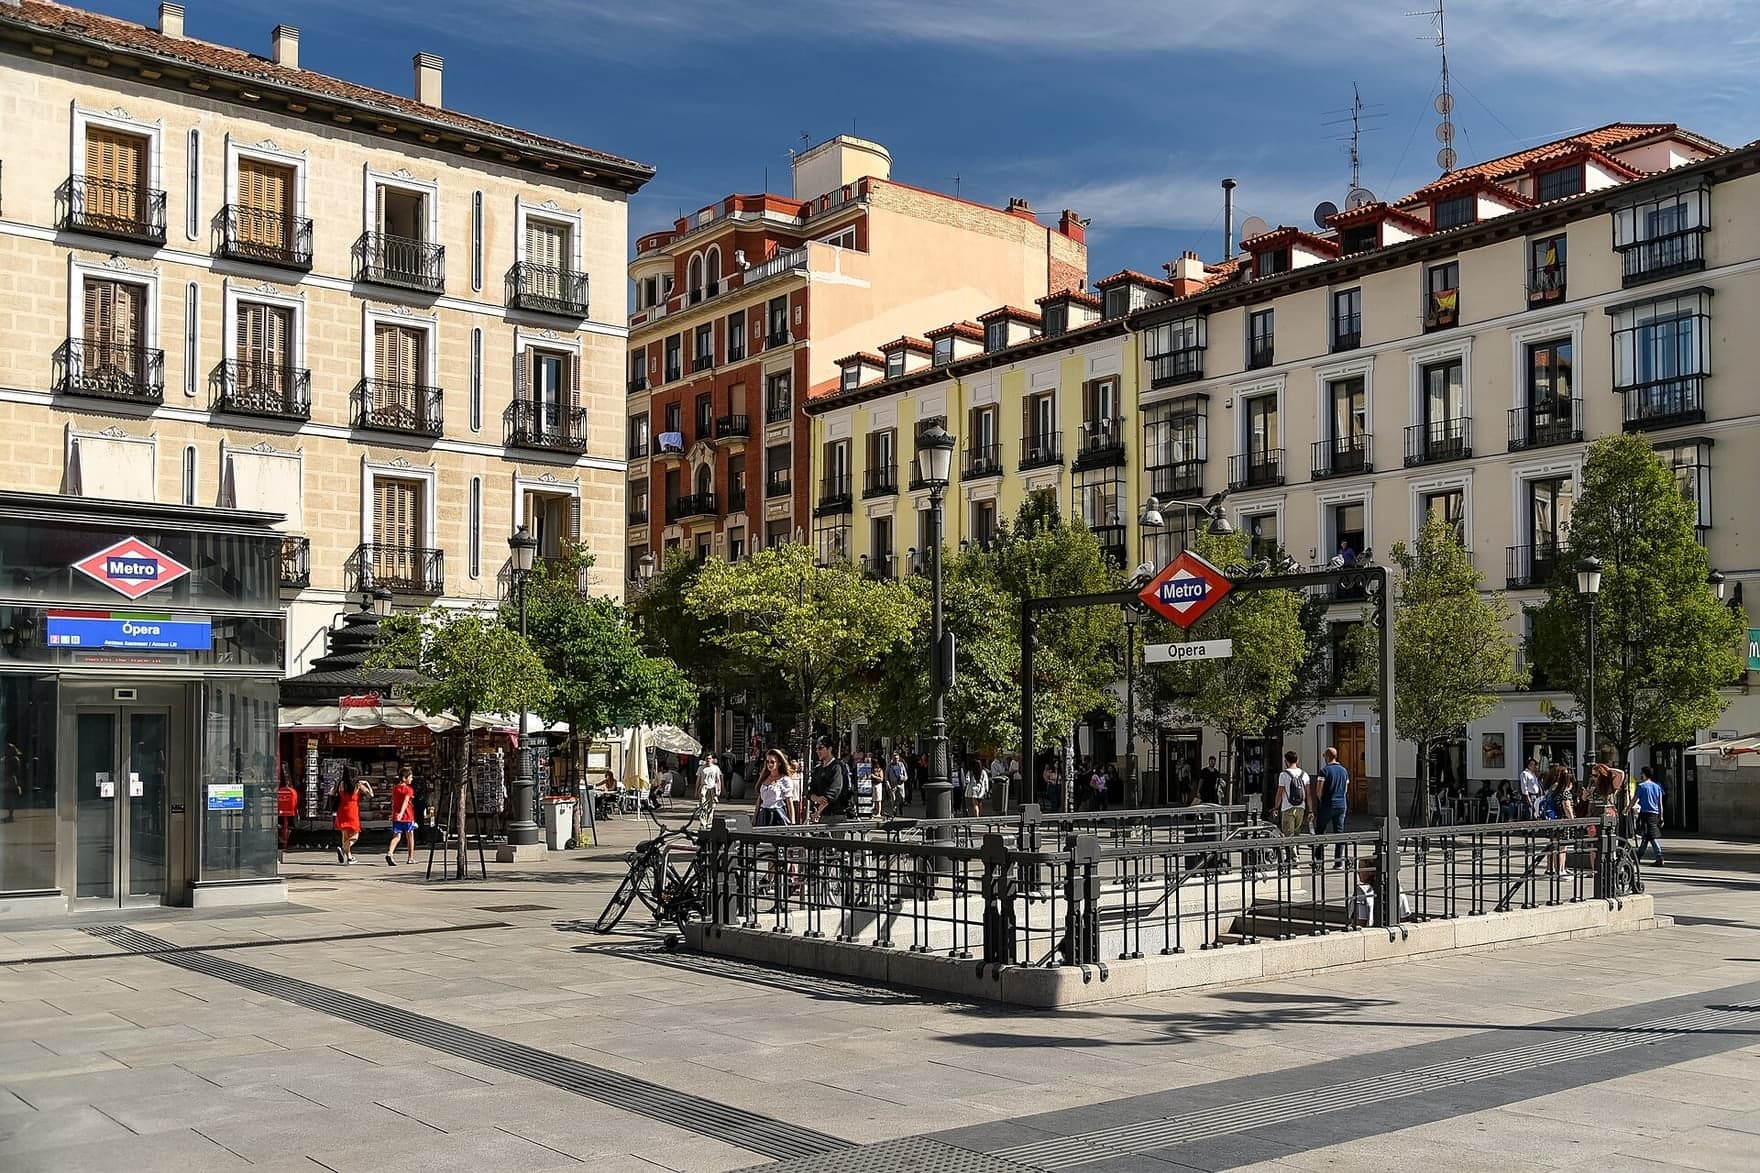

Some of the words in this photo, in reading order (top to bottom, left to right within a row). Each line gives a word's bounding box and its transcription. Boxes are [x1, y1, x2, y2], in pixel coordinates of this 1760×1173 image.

[110, 561, 155, 575] Metro
[1163, 583, 1202, 599] Metro
[122, 620, 160, 637] Ópera
[1168, 644, 1206, 659] Opera
